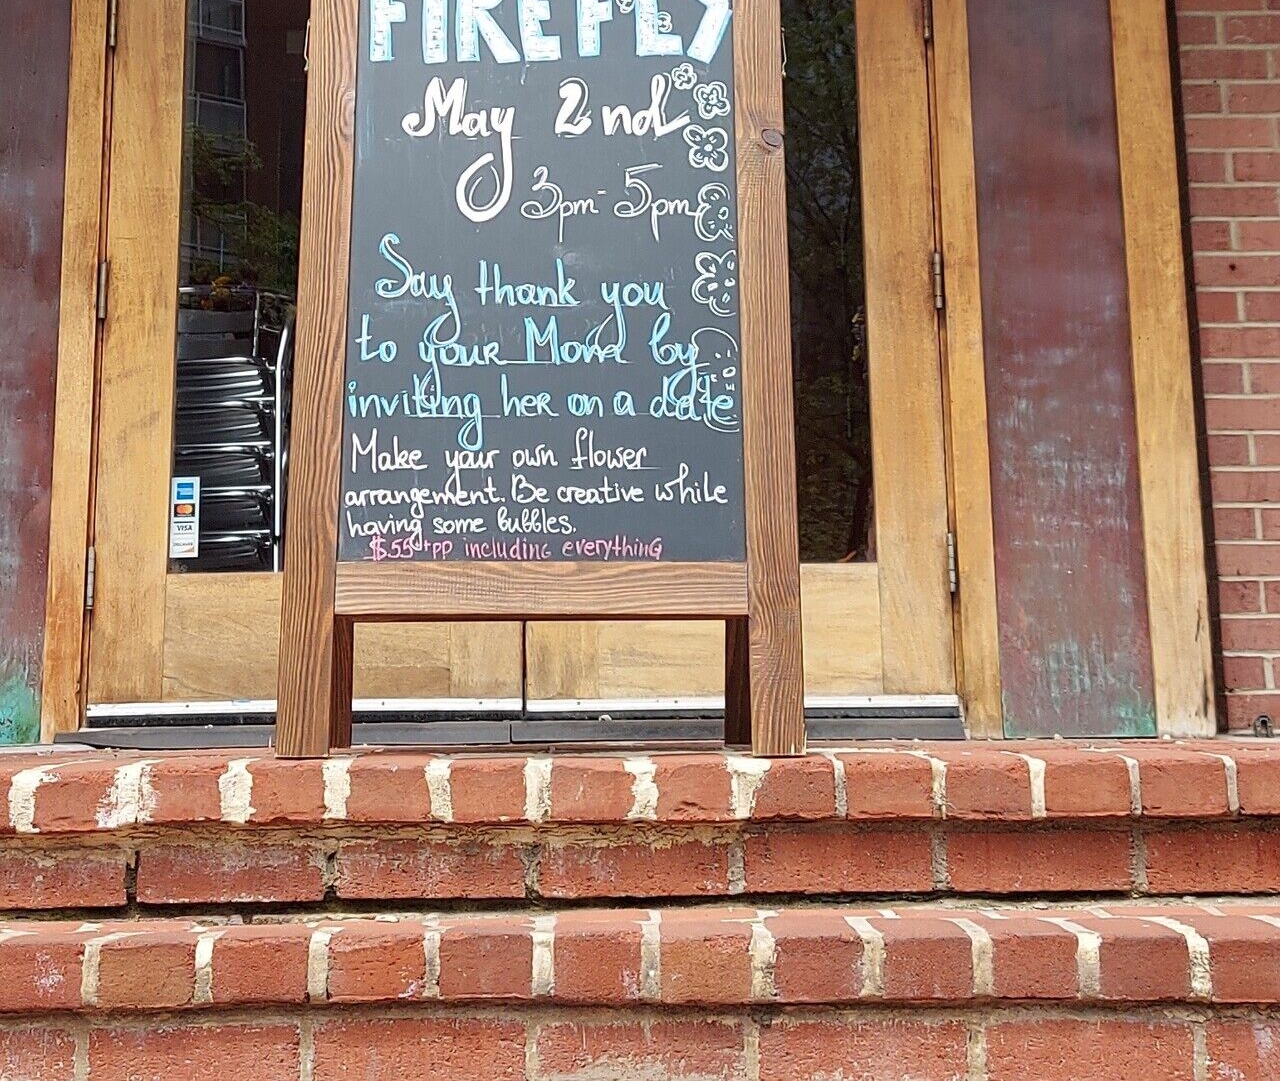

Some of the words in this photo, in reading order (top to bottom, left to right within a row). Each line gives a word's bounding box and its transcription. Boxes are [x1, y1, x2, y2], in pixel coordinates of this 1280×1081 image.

[401, 77, 516, 221] May
[554, 73, 690, 139] 2nd
[375, 233, 462, 344] Say
[475, 258, 580, 306] thank
[586, 279, 670, 357] you
[355, 313, 397, 365] to
[418, 341, 506, 409] your
[649, 312, 702, 403] by
[347, 374, 484, 452] inviting
[500, 373, 559, 418] her
[567, 390, 604, 419] on
[613, 390, 636, 417] a
[649, 372, 736, 422] date
[344, 481, 506, 519] arrangement.
[511, 478, 549, 504] Be
[557, 482, 645, 505] creative
[654, 464, 730, 505] while
[351, 427, 428, 473] Make
[444, 448, 500, 496] your
[512, 447, 559, 468] own
[570, 427, 648, 470] flower
[345, 511, 423, 550] having
[433, 514, 487, 535] some
[497, 507, 578, 536] bubbles.
[464, 533, 552, 561] including
